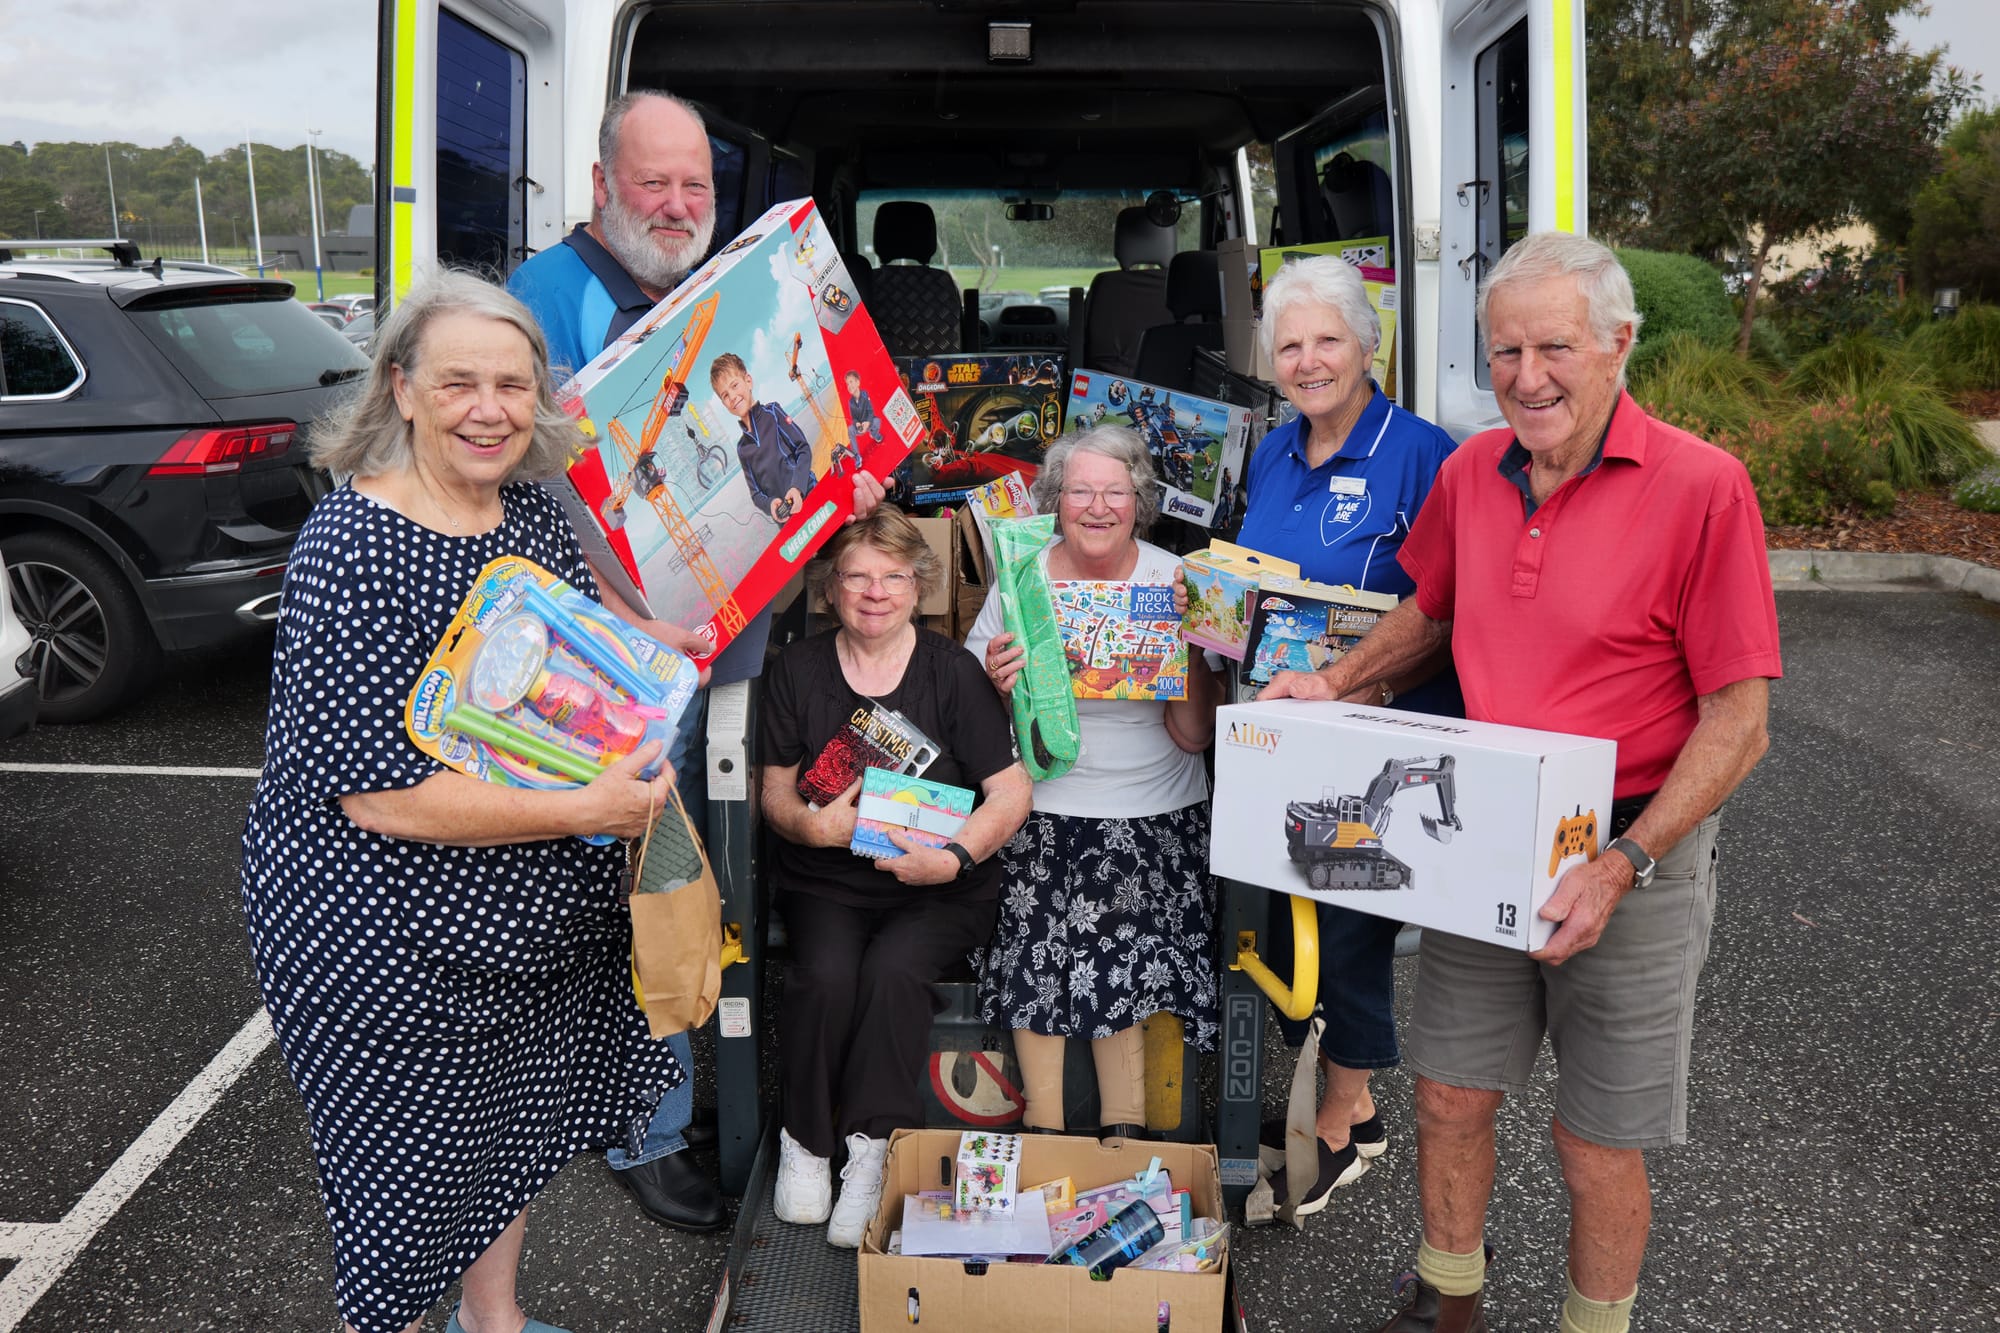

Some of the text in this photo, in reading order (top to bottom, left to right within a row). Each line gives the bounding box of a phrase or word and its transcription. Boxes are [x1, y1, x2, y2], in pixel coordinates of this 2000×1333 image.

[817, 255, 839, 286] CONTROLLER
[948, 372, 981, 383] WARS
[951, 363, 981, 373] STAR
[1168, 496, 1205, 517] AVENGERS
[788, 504, 830, 556] MEGA CRANE
[1137, 592, 1171, 603] BOOK
[1158, 677, 1174, 690] 100
[413, 671, 442, 731] BILLION
[850, 707, 915, 761] CHRISTMAS
[1225, 721, 1281, 755] Alloy
[1497, 902, 1516, 928] 13
[1495, 926, 1517, 938] CHANNEL
[1229, 1000, 1253, 1096] RICON
